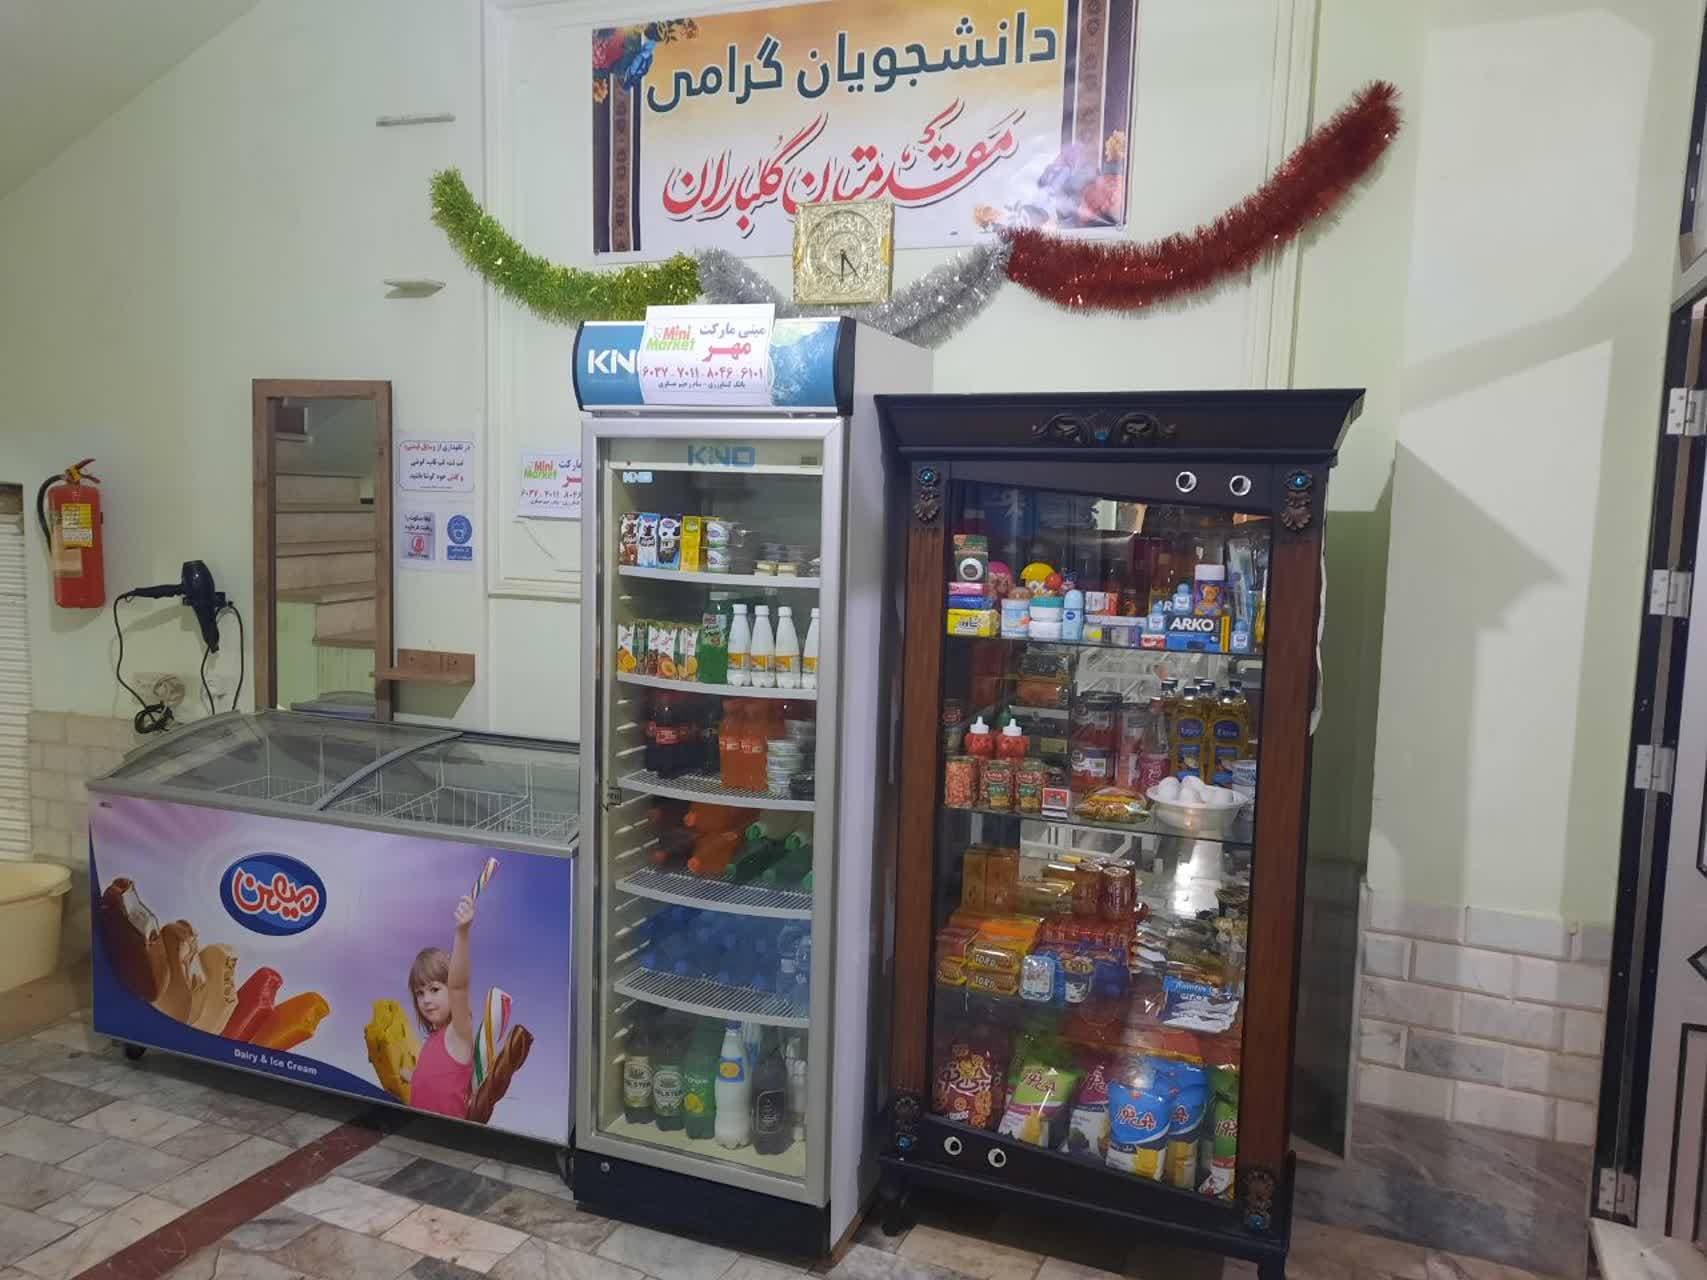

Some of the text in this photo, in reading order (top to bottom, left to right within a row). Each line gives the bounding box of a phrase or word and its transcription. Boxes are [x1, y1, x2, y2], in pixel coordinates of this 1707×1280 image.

[647, 11, 1057, 112] دانشجویان گرامی
[662, 112, 829, 239] گلباران
[663, 324, 692, 340] Mini
[700, 321, 736, 340] مارکت
[645, 337, 698, 351] Market
[701, 341, 752, 362] مهر
[587, 348, 639, 375] KN
[534, 459, 554, 472] Mini
[1168, 616, 1215, 632] ARKO
[232, 867, 320, 921] میهن
[233, 1048, 318, 1076] Dairy & Ice Cream
